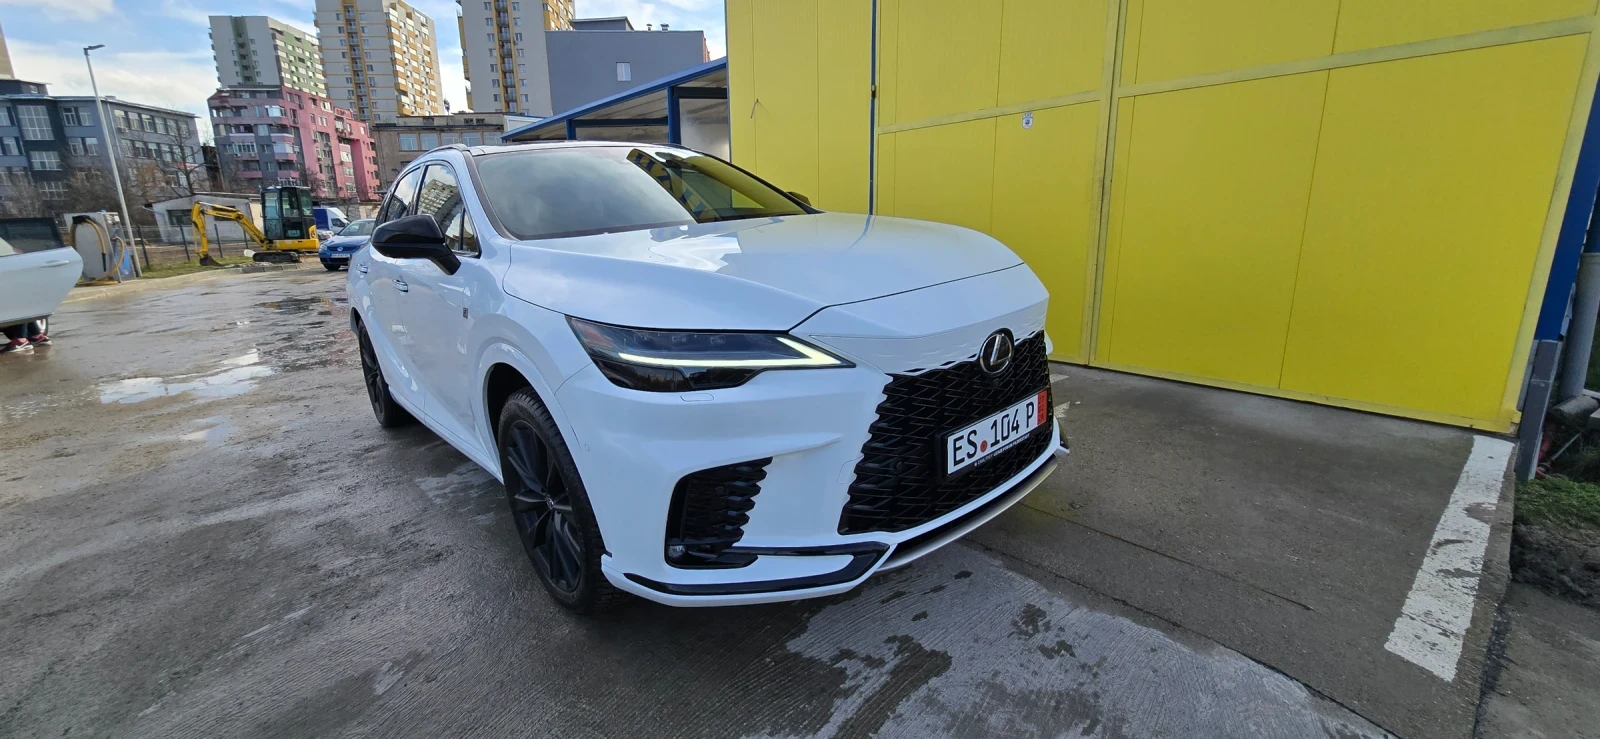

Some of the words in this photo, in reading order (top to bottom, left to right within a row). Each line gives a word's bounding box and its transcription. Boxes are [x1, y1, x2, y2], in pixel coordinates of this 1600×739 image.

[953, 429, 978, 467] ES
[990, 408, 1020, 448] 104
[1025, 401, 1035, 429] P
